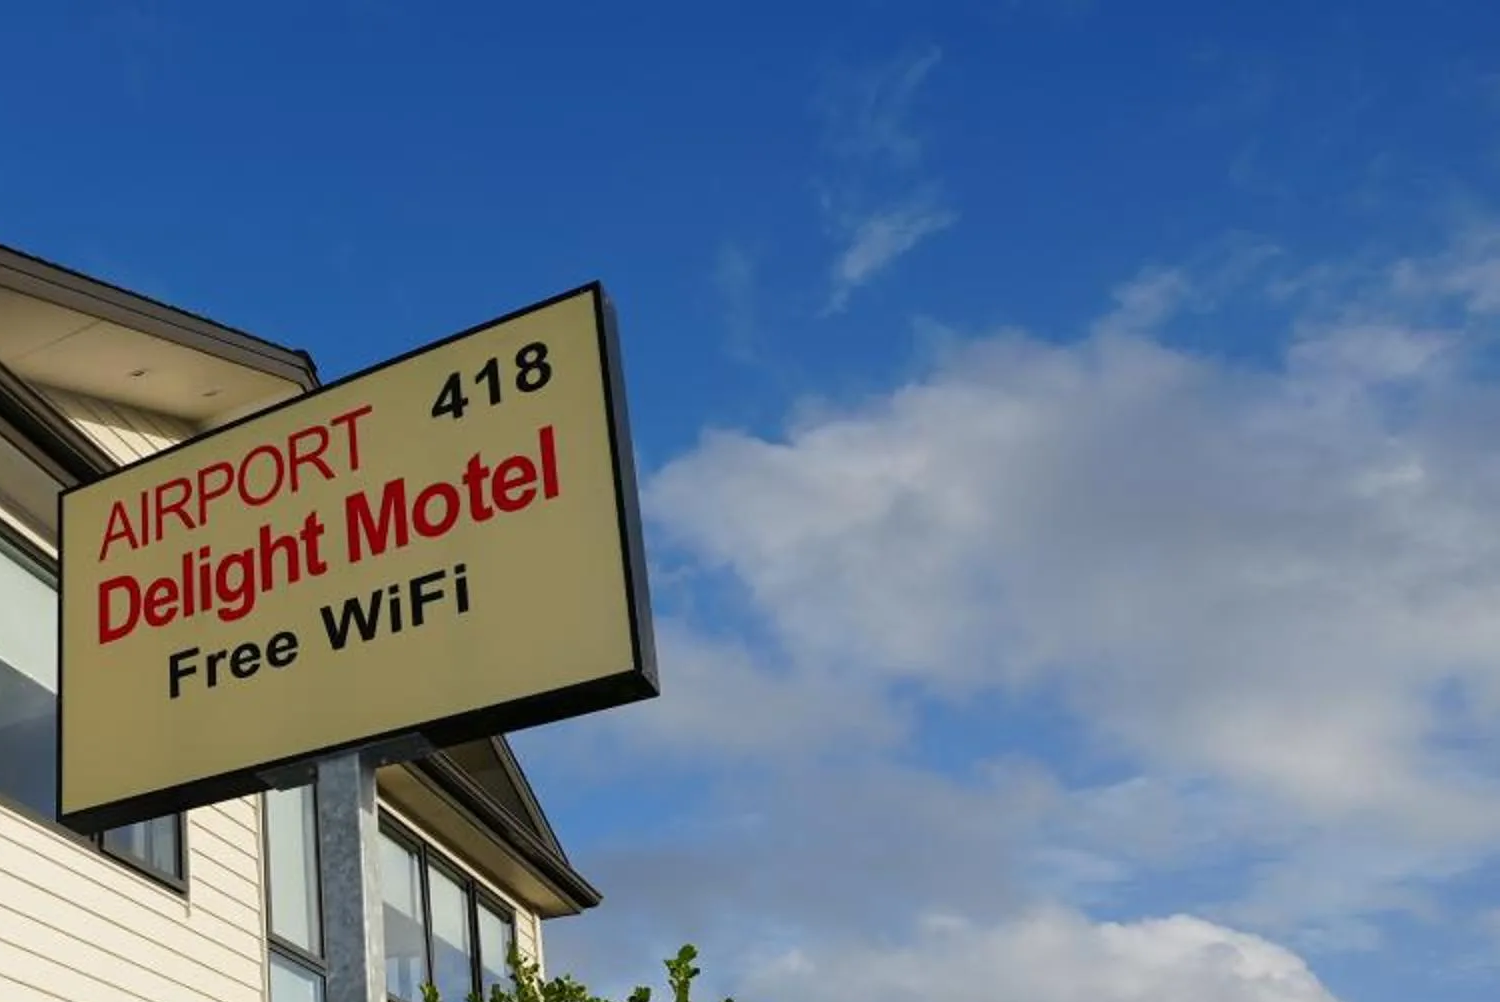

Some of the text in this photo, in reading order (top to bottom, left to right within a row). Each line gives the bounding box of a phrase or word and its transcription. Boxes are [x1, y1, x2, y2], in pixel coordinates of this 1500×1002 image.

[431, 341, 552, 419] 418
[98, 426, 560, 645] Delight Motel
[99, 406, 372, 562] AIRPORT
[169, 563, 470, 699] Free WiFi
